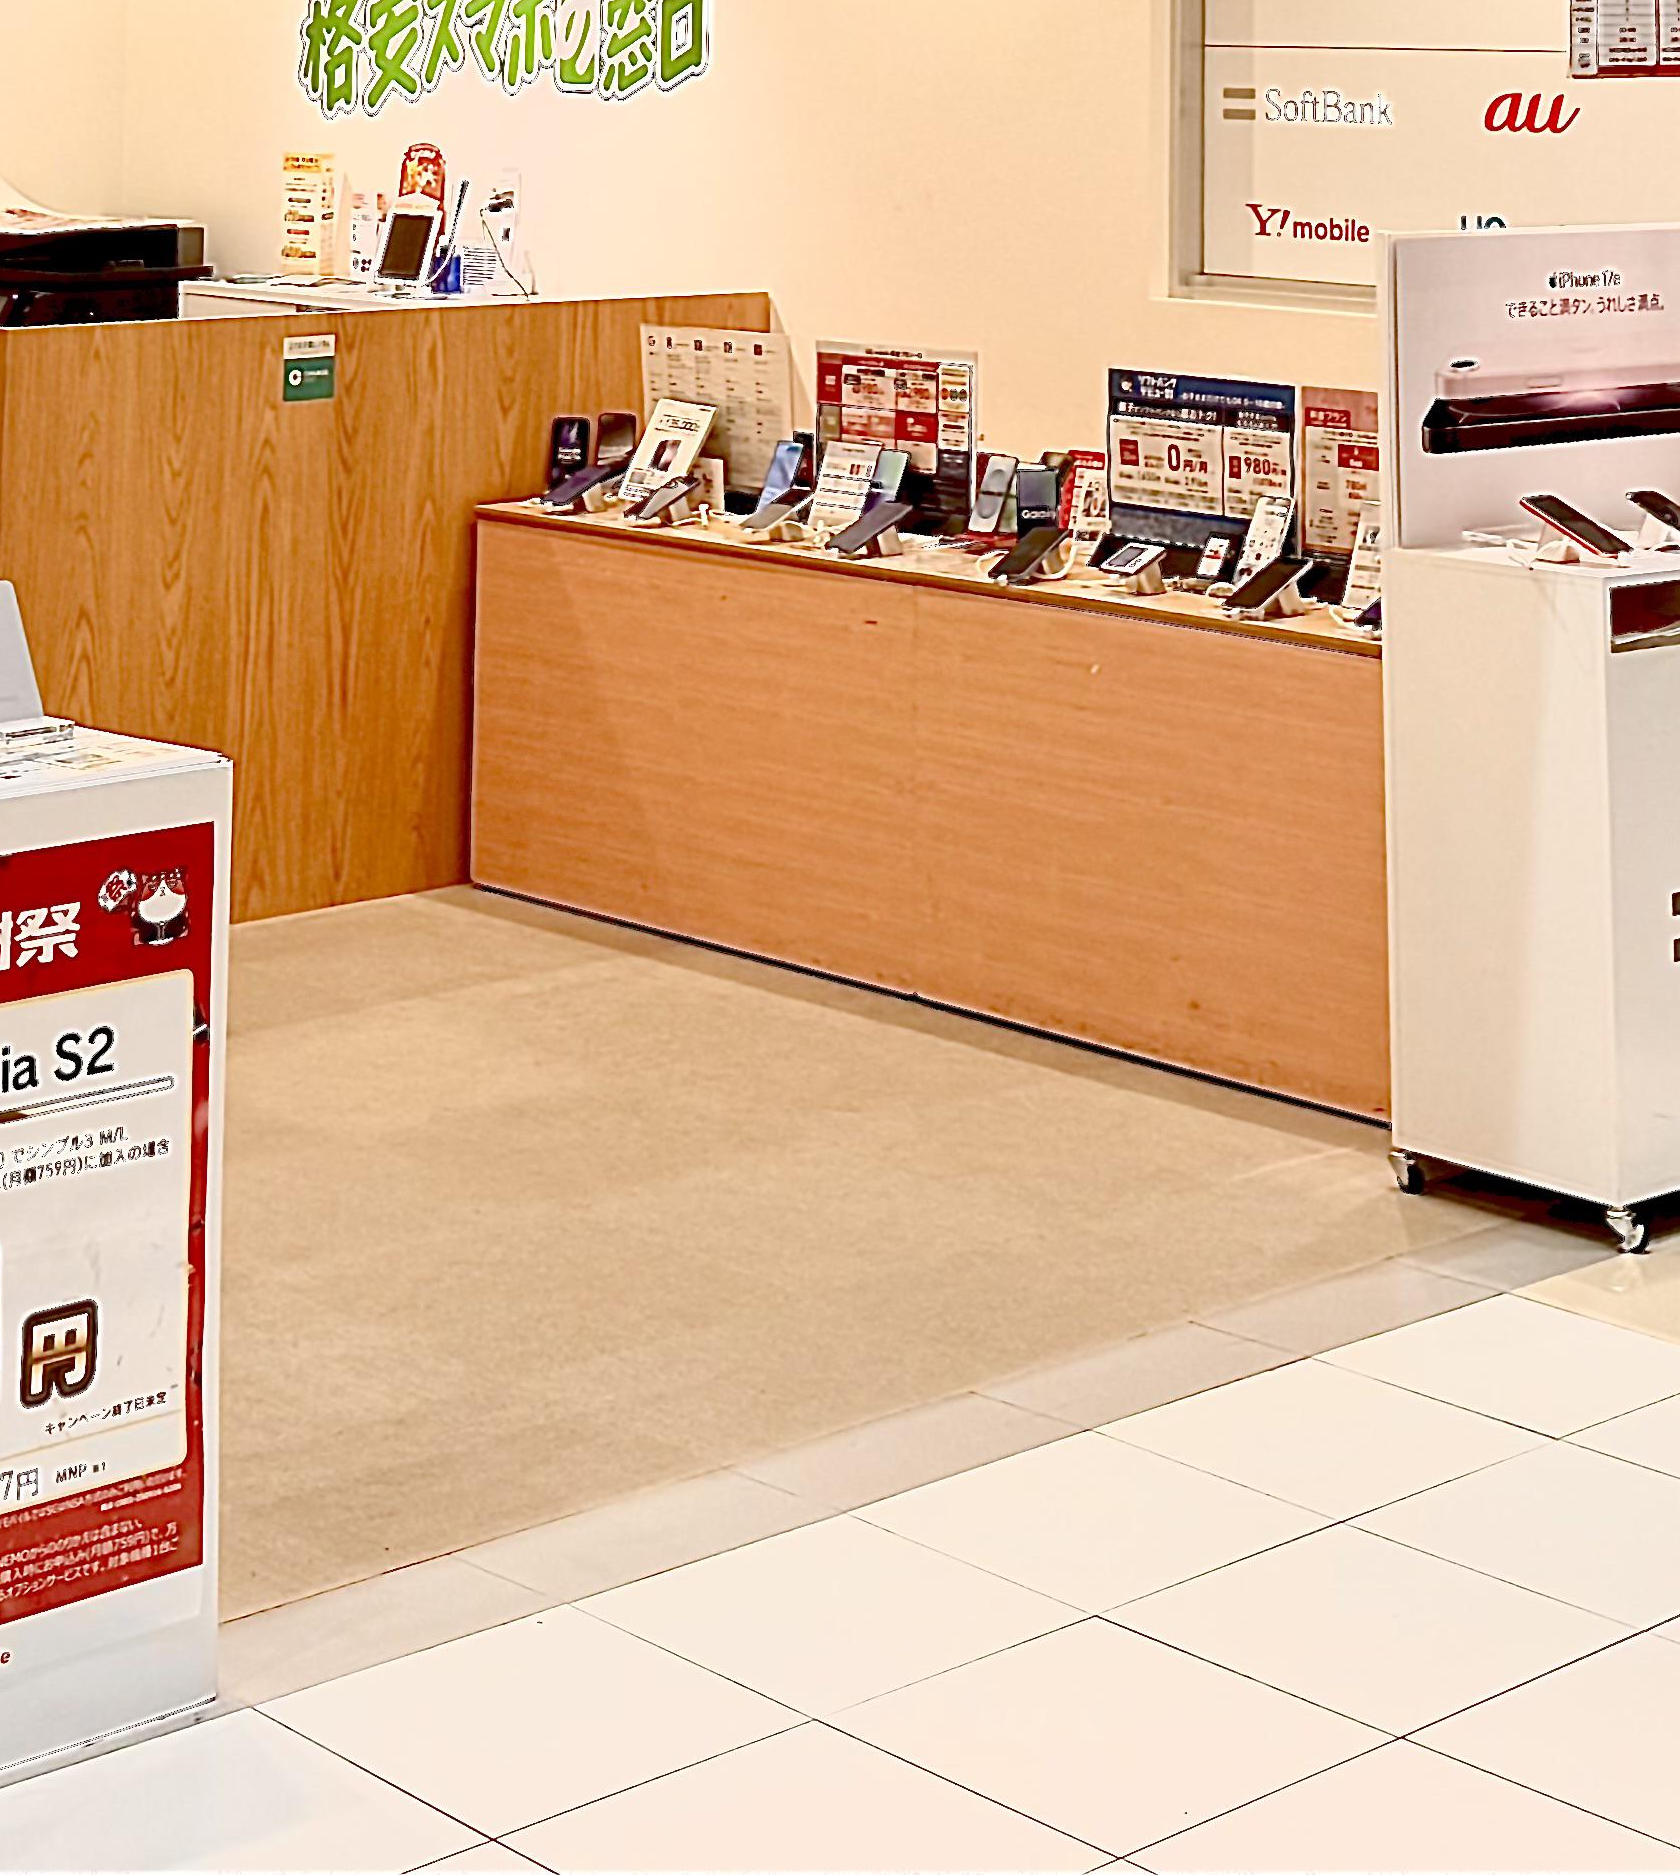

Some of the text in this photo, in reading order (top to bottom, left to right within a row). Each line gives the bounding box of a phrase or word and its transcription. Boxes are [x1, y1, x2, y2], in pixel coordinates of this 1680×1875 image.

[1265, 87, 1392, 127] SoftBank
[1483, 89, 1581, 134] au
[54, 1025, 116, 1082] S2
